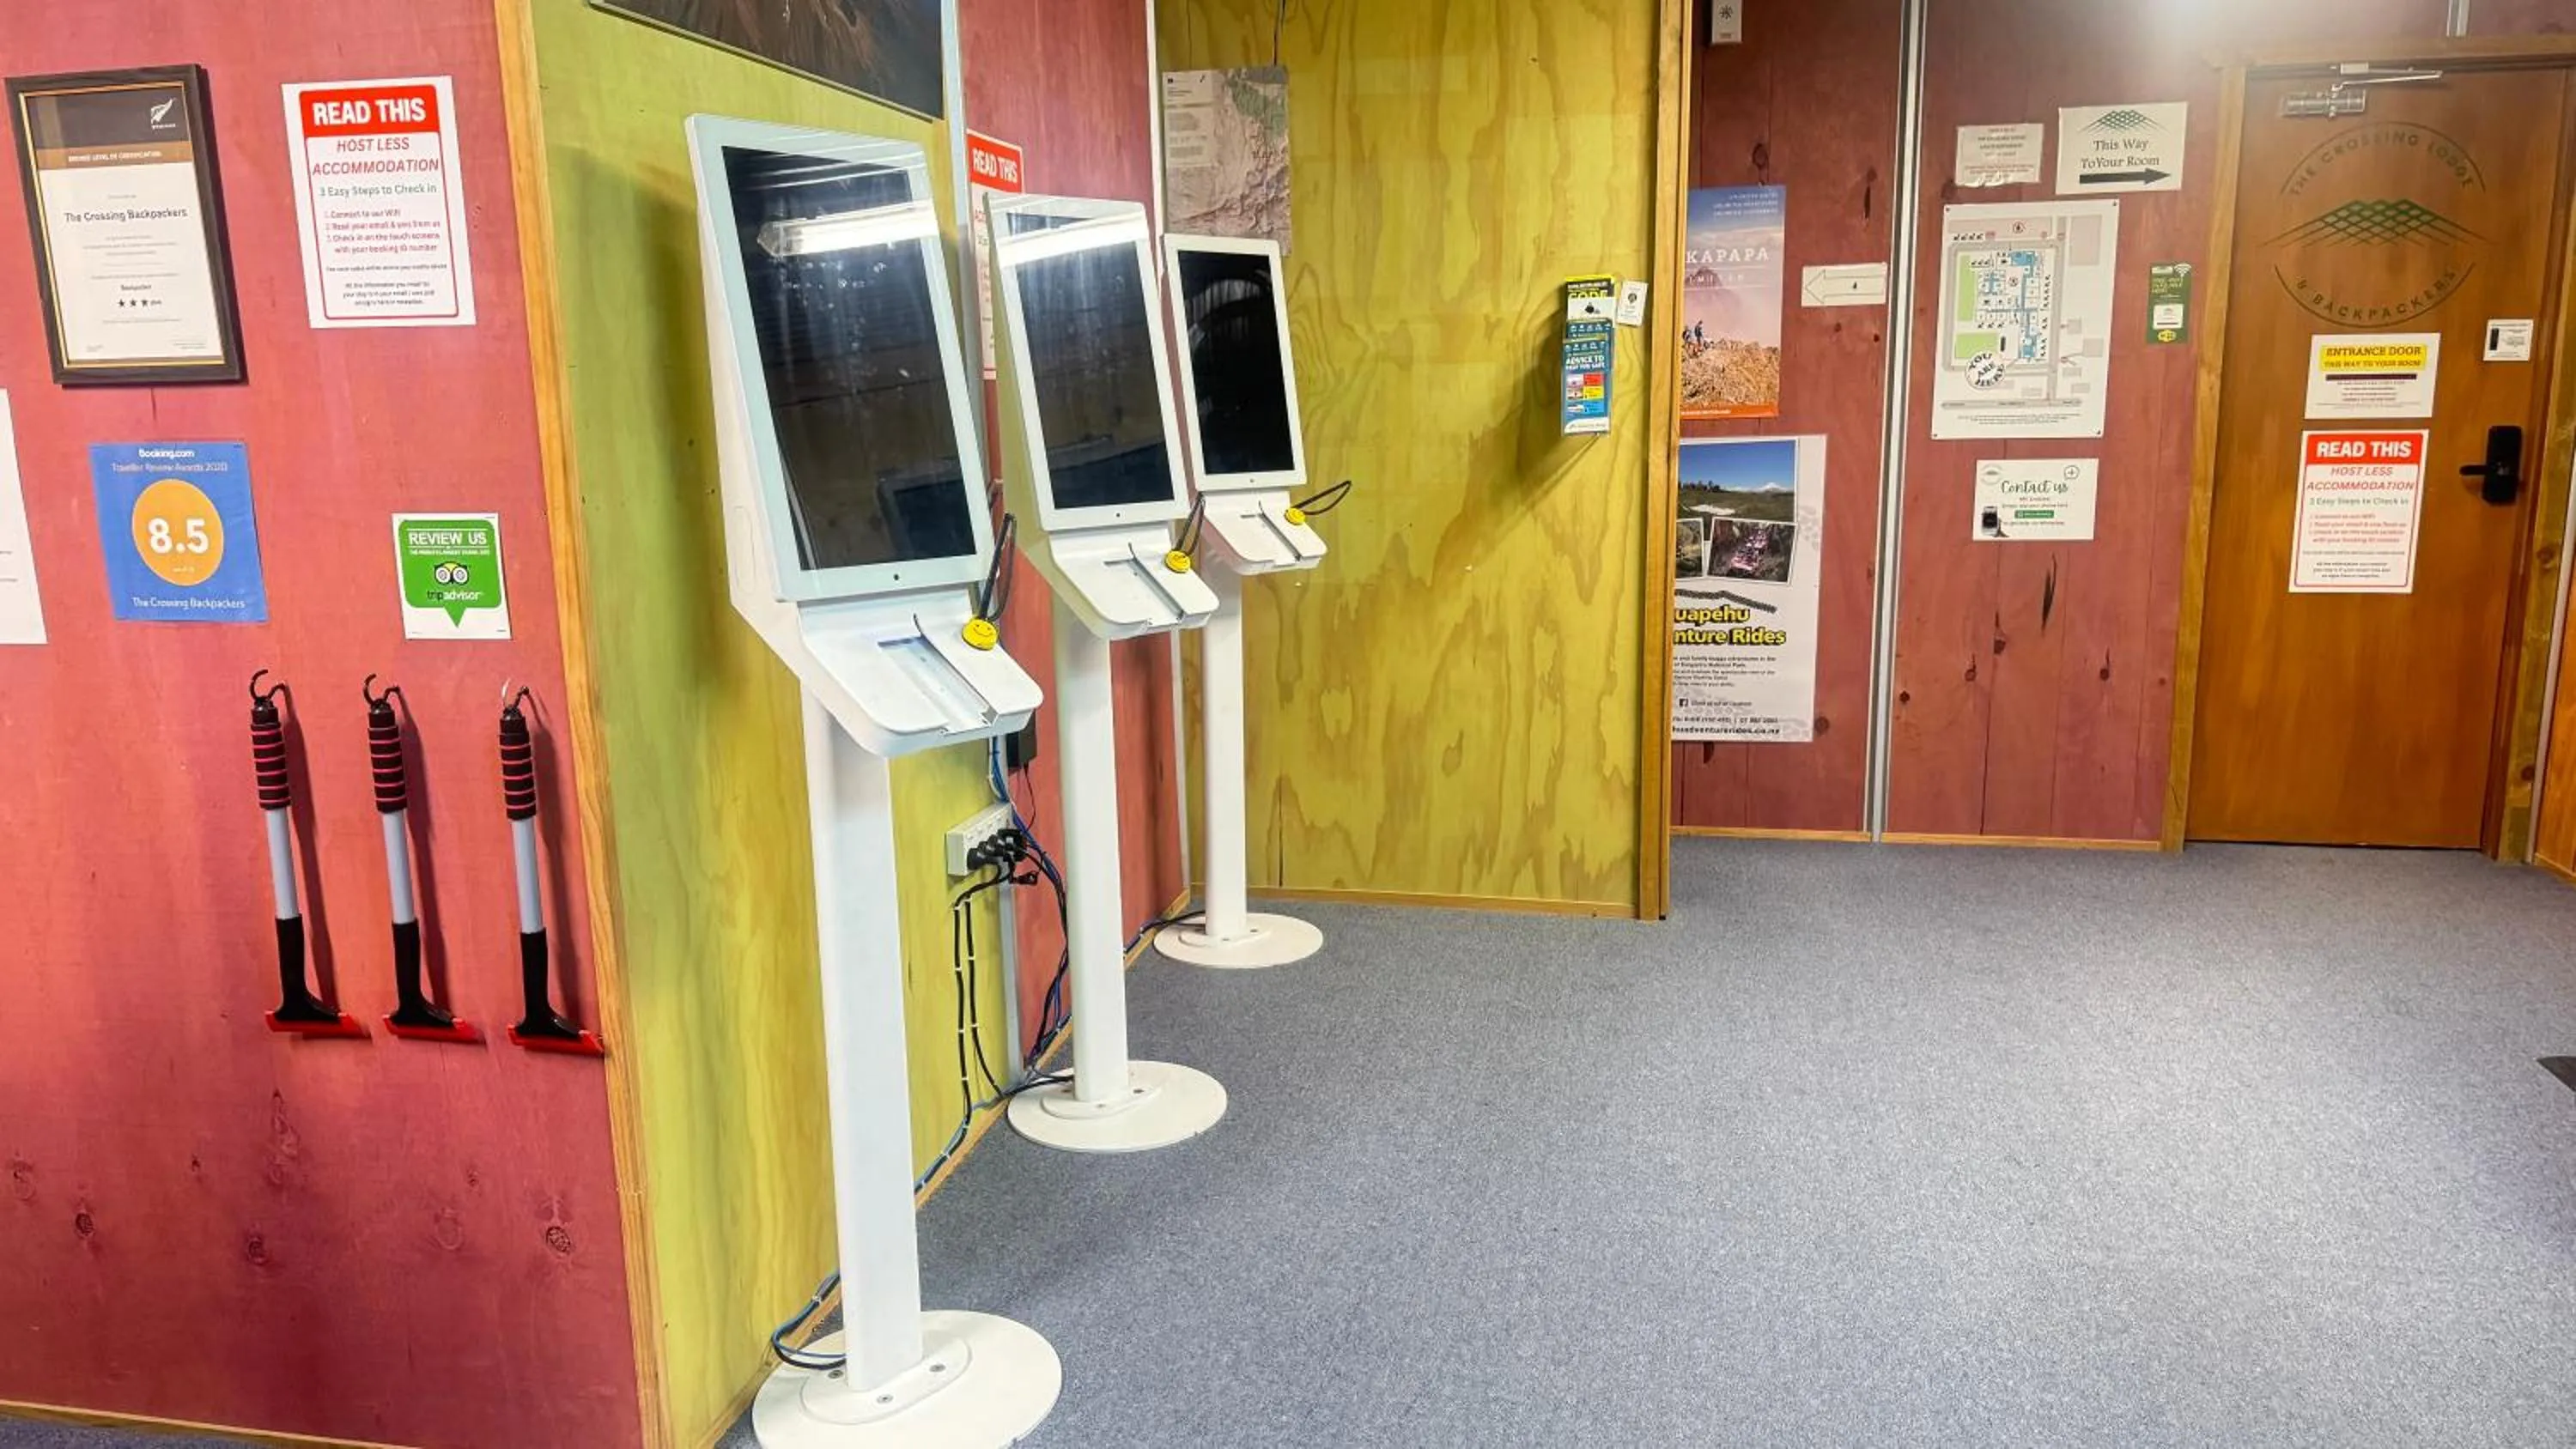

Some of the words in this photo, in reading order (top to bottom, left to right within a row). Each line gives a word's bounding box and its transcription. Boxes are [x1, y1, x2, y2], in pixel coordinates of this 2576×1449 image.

[313, 100, 372, 126] READ
[374, 97, 427, 123] THIS
[337, 138, 374, 153] HOST
[376, 136, 410, 151] LESS
[2093, 139, 2119, 151] This
[2123, 138, 2149, 152] Way
[313, 158, 440, 176] ACCOMMODATION
[972, 147, 997, 177] READ
[997, 155, 1018, 184] THIS
[2126, 155, 2160, 167] Room
[2290, 166, 2317, 196] THE
[2320, 130, 2419, 164] CROSSING
[2427, 142, 2474, 188] LODGE
[328, 186, 349, 198] Easy
[352, 185, 380, 198] Steps
[382, 185, 392, 194] to
[394, 183, 425, 194] Check
[427, 183, 437, 192] in
[64, 212, 82, 222] The
[83, 209, 125, 221] Crossing
[127, 208, 188, 219] Backpackers
[1686, 247, 1771, 264] KAPAPA
[2312, 271, 2457, 320] BACKPACKERS
[2326, 346, 2386, 356] ENTRANCE
[2388, 345, 2421, 356] DOOR
[1967, 353, 1993, 371] YOU
[1978, 361, 1996, 379] ARE
[138, 448, 196, 459] Booking.com
[2316, 440, 2366, 458] READ
[2370, 440, 2413, 458] THIS
[2330, 466, 2364, 476] HOST
[2365, 466, 2394, 476] LESS
[2002, 480, 2051, 494] Contact
[2053, 482, 2069, 494] us
[2306, 481, 2415, 491] ACCOMMODATION
[147, 517, 210, 555] 8.5
[409, 531, 463, 545] REVIEW
[468, 531, 487, 545] US
[1674, 604, 1750, 627] uapehu
[1674, 627, 1728, 646] nture
[1728, 626, 1786, 646] Rides
